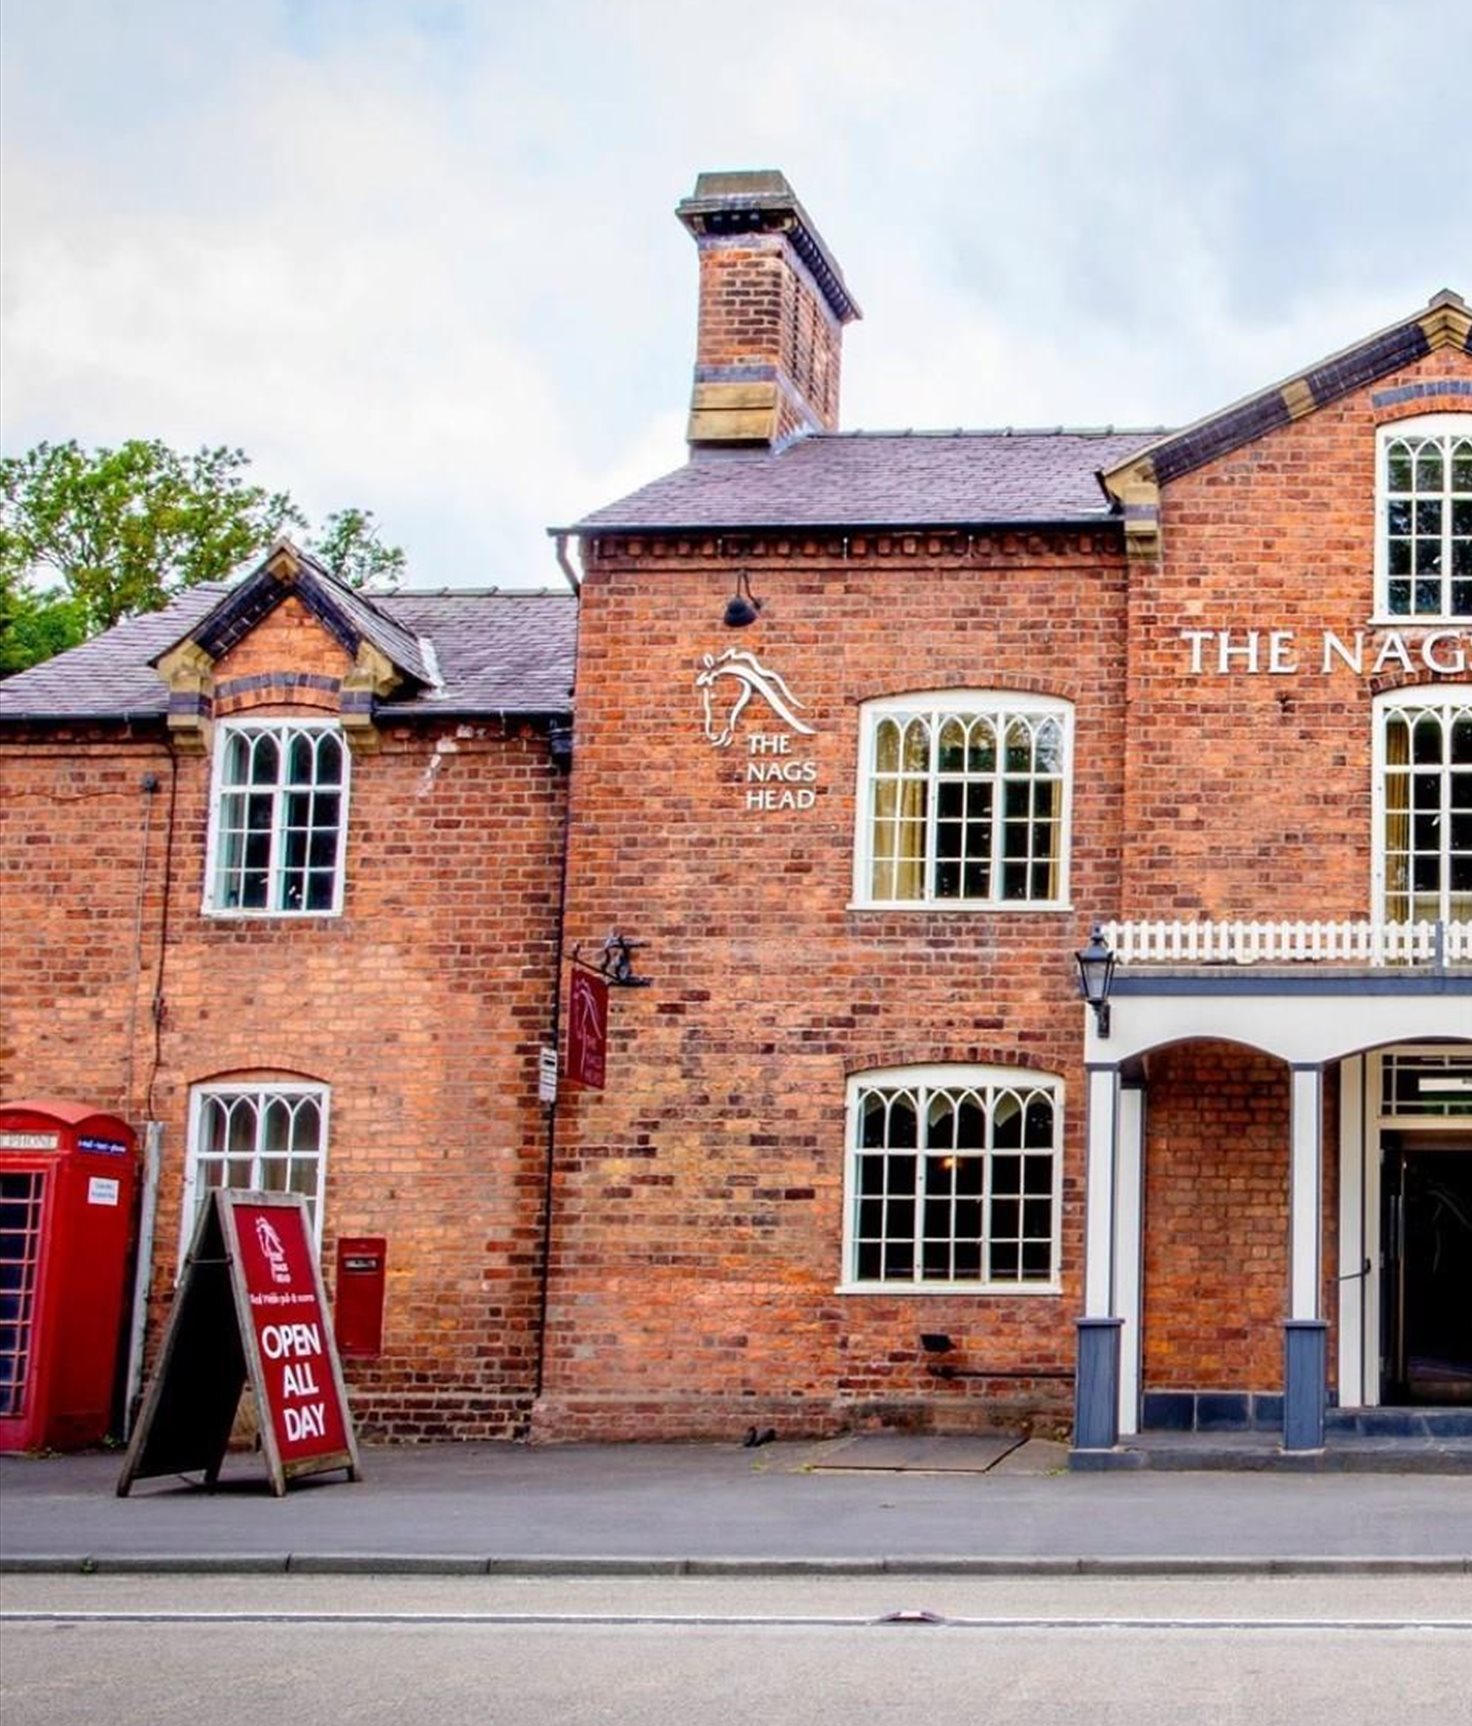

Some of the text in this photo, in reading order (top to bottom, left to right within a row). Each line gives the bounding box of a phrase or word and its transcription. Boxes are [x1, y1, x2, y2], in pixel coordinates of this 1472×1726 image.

[1180, 629, 1298, 675] THE
[748, 734, 792, 754] THE
[747, 761, 817, 782] NAGS
[746, 789, 815, 810] HEAD
[261, 1322, 323, 1360] OPEN
[283, 1361, 320, 1399] ALL
[283, 1402, 326, 1442] DAY
